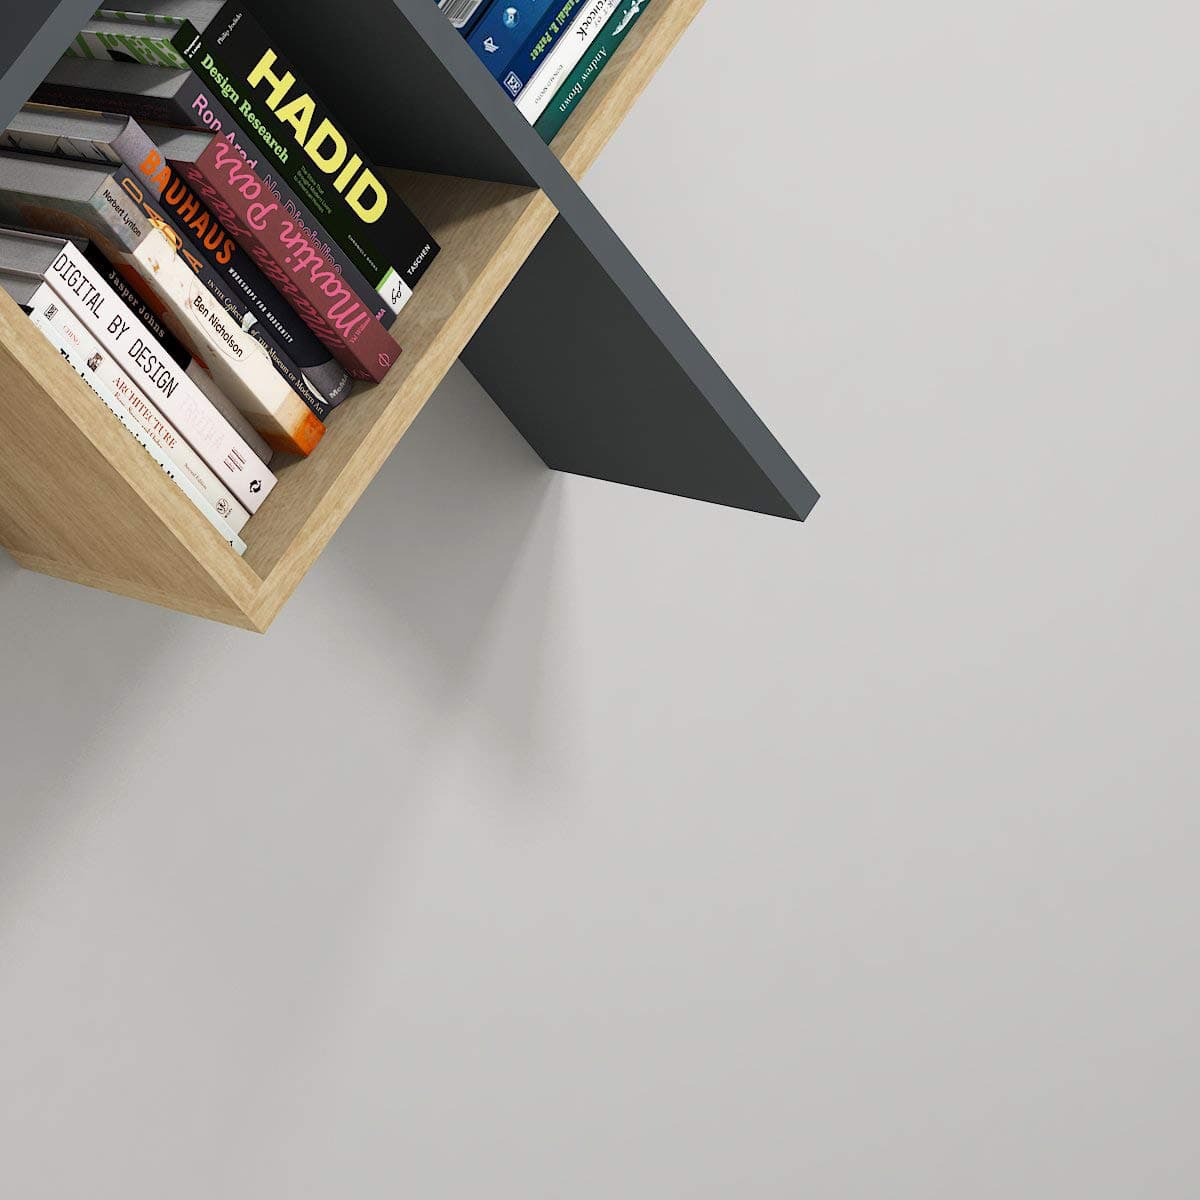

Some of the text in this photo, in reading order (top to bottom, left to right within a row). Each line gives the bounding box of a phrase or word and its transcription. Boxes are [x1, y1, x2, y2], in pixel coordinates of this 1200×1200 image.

[530, 32, 552, 61] Parker
[559, 46, 607, 112] Andrew Brown
[191, 93, 222, 131] Ron
[200, 53, 289, 165] Design Research
[246, 48, 388, 224] HADID
[103, 188, 142, 237] Norbert Lynton
[121, 177, 203, 273] DADA
[138, 148, 236, 264] BAUHAUS
[214, 142, 366, 337] Martin Parr
[407, 244, 431, 276] TASCHEN
[52, 253, 105, 319] DIGITAL
[106, 314, 130, 341] BY
[128, 338, 179, 399] DESIGN
[108, 271, 166, 338] Jasper Johns
[193, 295, 243, 358] Ben Nicholson
[228, 267, 293, 343] WORKSHOPS FOR MODERNITY
[112, 377, 178, 449] ARCHITECTURE
[267, 348, 291, 374] Museum
[293, 379, 316, 403] Modern
[313, 401, 325, 414] Art
